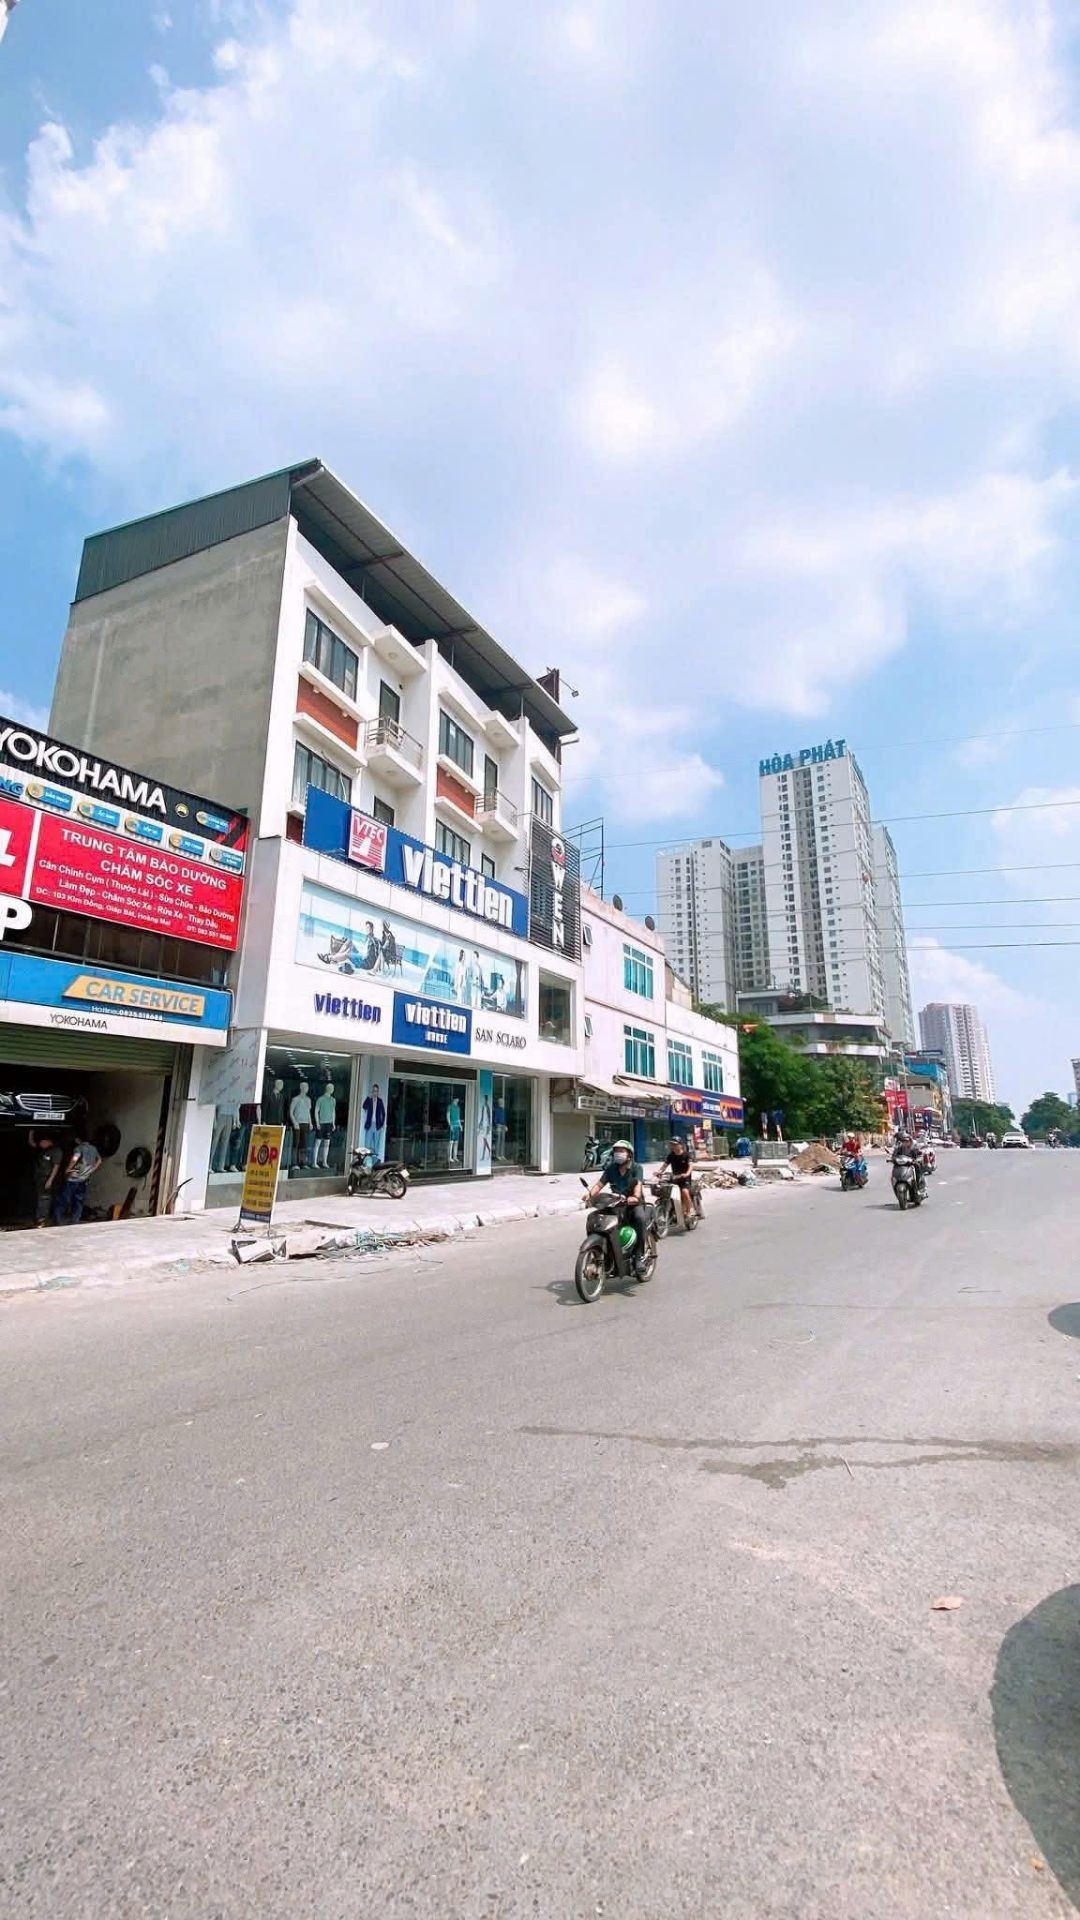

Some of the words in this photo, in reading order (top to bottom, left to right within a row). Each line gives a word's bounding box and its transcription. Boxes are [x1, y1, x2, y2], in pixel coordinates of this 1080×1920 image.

[0, 727, 167, 814] YOKOHAMA
[759, 752, 794, 777] HÒA
[799, 739, 846, 767] PHÁT
[61, 828, 114, 854] TRUNG
[118, 846, 147, 865] TÂM
[150, 856, 178, 875] BẢO
[181, 867, 227, 890] DƯỠNG
[101, 860, 142, 881] CHĂM
[146, 873, 174, 891] SÓC
[176, 882, 193, 896] XE
[402, 843, 513, 930] viettien
[551, 837, 566, 949] OWEN
[85, 981, 125, 1002] CAR
[129, 988, 199, 1013] SERVICE
[314, 993, 382, 1023] viettien
[49, 1013, 108, 1030] YOKOHAMA
[405, 1002, 467, 1033] viettien
[475, 1027, 493, 1043] SAN
[496, 1031, 527, 1049] SCIARO
